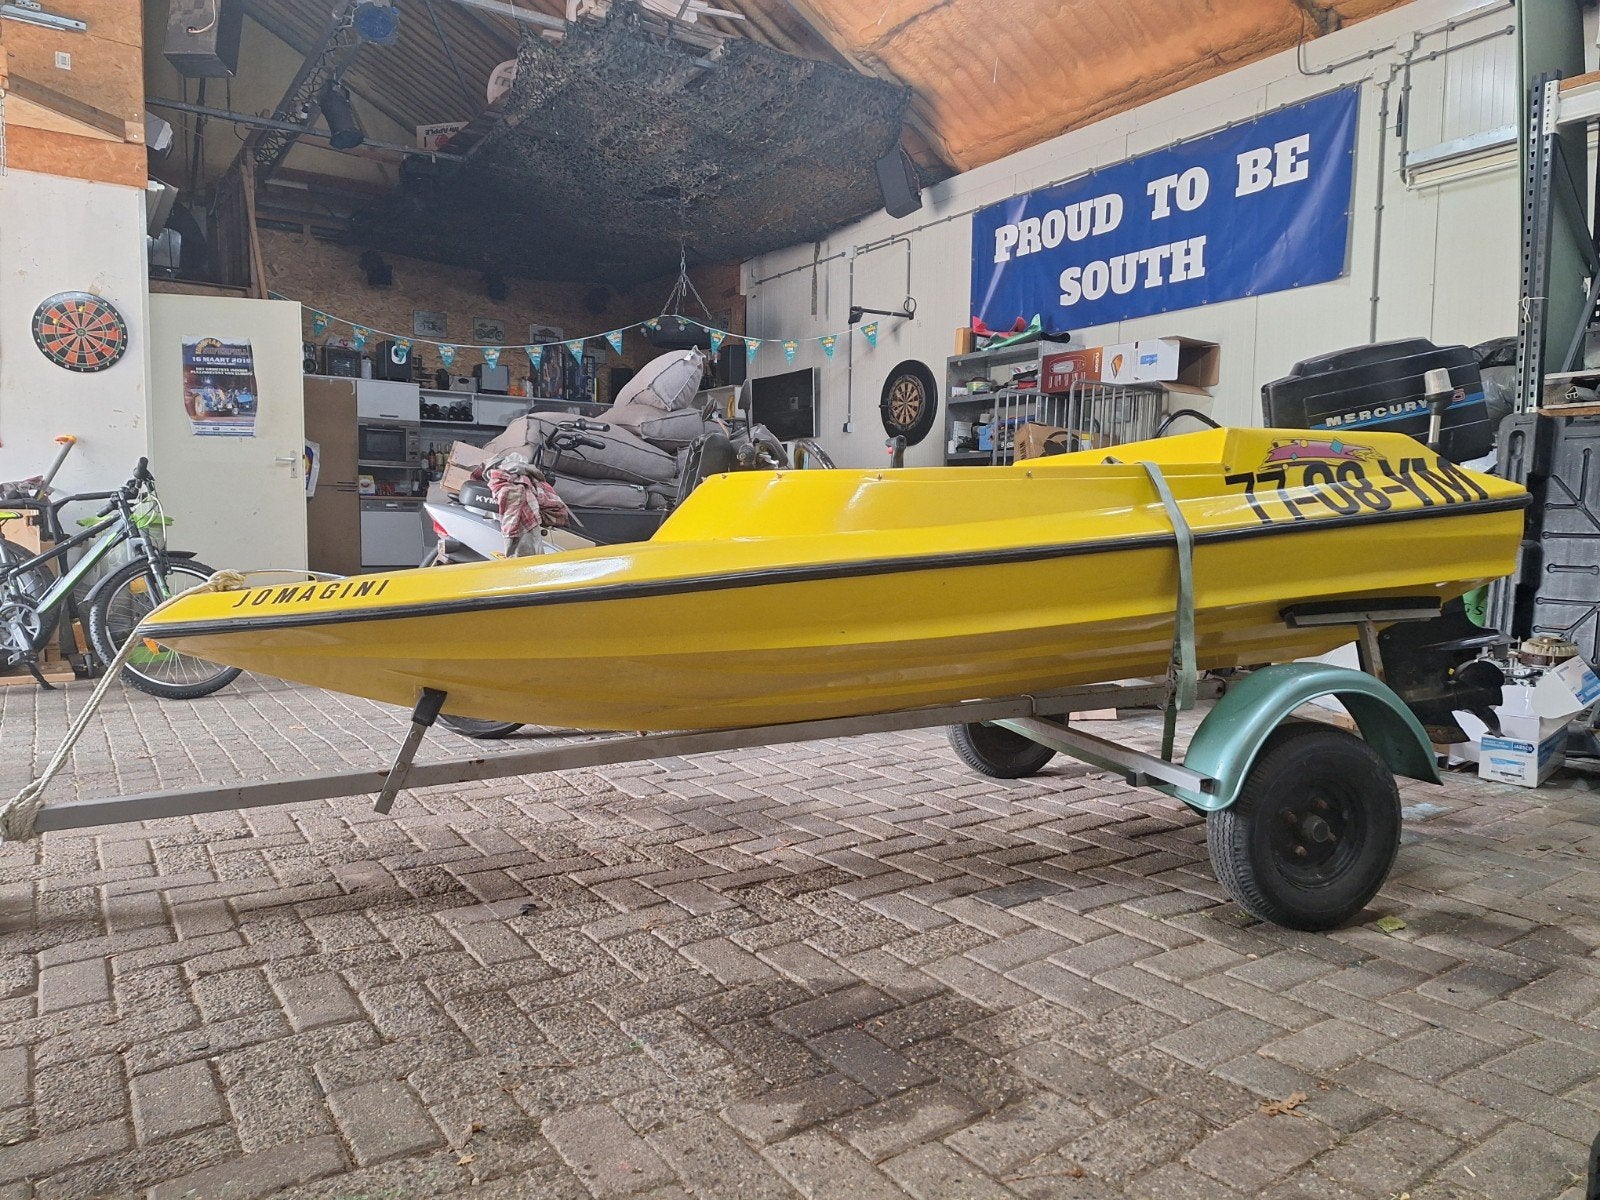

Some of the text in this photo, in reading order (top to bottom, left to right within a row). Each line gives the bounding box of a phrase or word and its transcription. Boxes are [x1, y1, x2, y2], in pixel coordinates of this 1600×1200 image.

[993, 133, 1310, 264] PROUD TO BE
[1059, 235, 1207, 307] SOUTH
[1326, 399, 1428, 428] MERCURY
[475, 494, 498, 505] KYM
[1224, 456, 1489, 525] 77-08-YM
[232, 579, 389, 608] JOMAGINI
